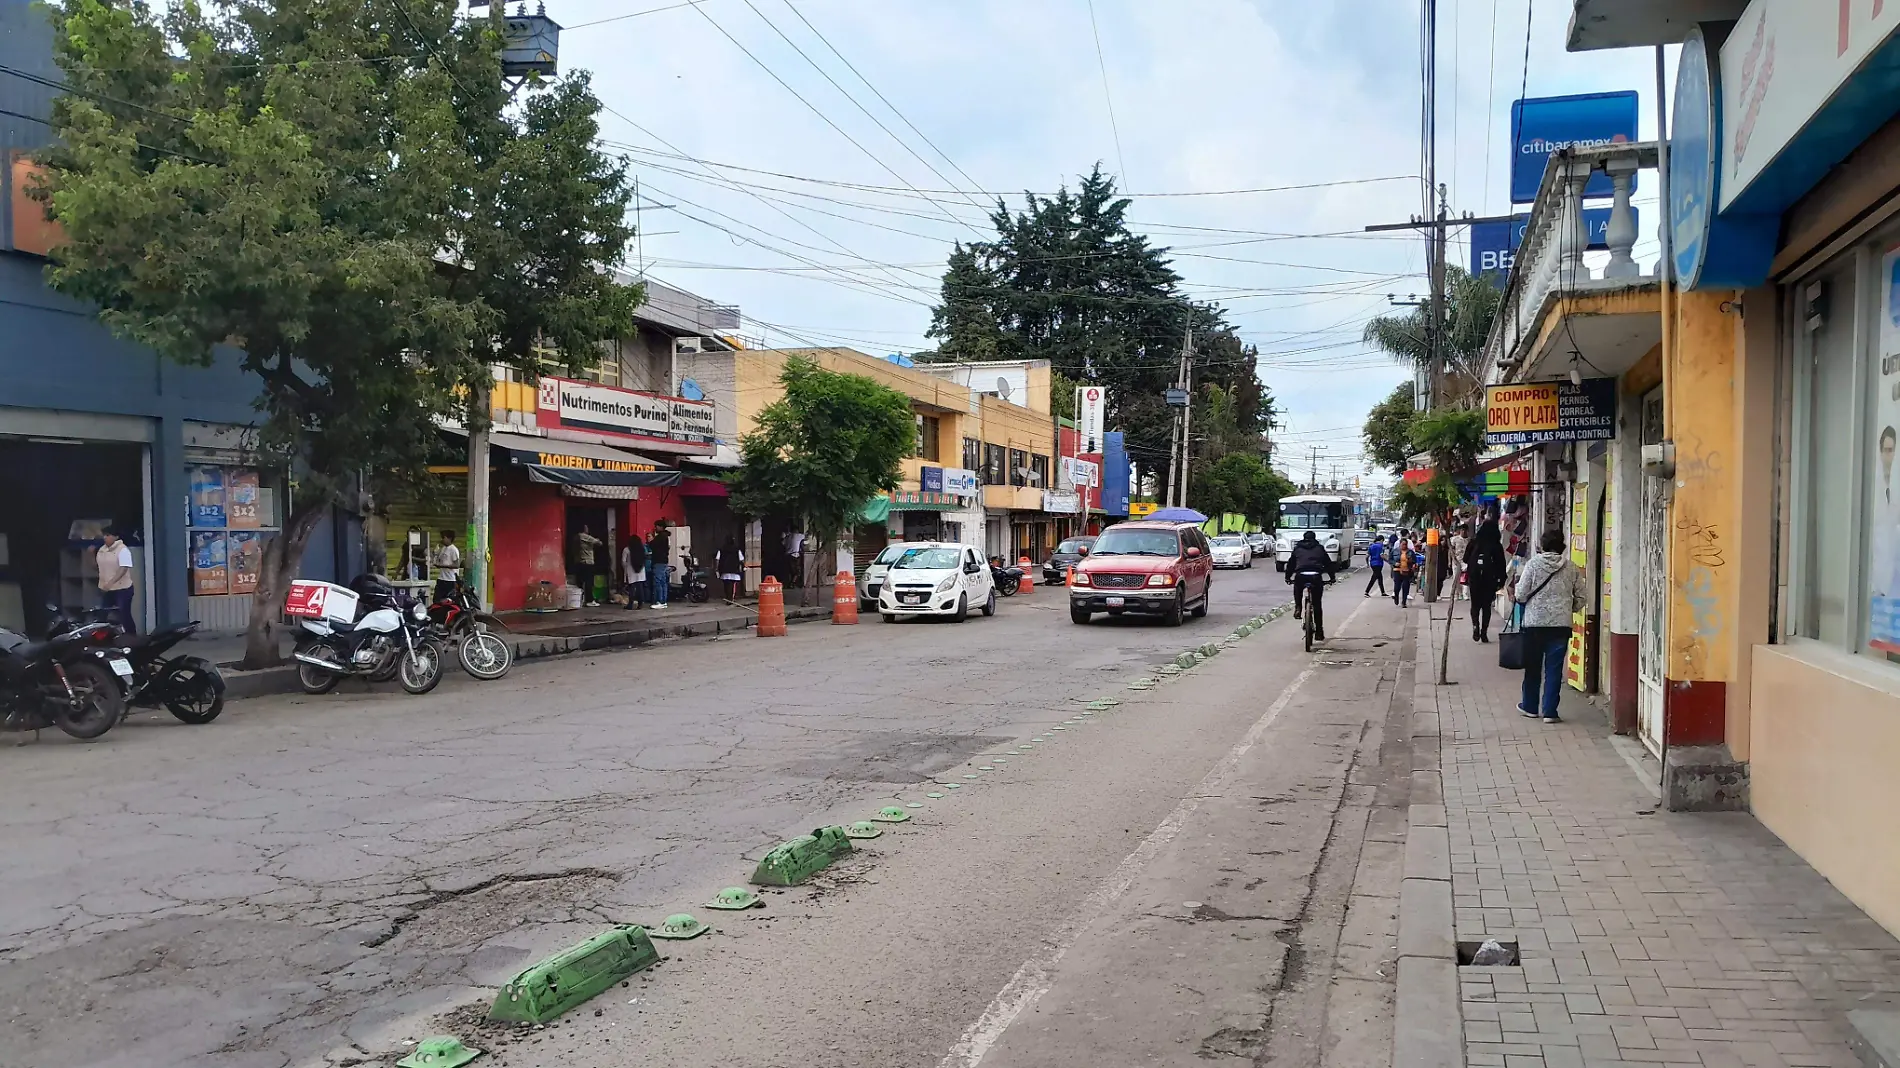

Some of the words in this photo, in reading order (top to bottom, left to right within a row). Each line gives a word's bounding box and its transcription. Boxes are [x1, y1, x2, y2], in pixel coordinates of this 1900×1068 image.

[1559, 385, 1581, 395] PILAS
[1495, 389, 1550, 403] COMPRO
[1559, 396, 1590, 406] PERNOS
[561, 391, 632, 418] Nutrimentos
[634, 404, 667, 423] Purina
[672, 403, 712, 421] Alimentos
[1559, 406, 1595, 416] CORREAS
[1488, 407, 1510, 426] ORO
[1513, 407, 1521, 425] Y
[1523, 405, 1557, 425] PLATA
[1559, 416, 1611, 427] EXTENSIBLES
[683, 422, 713, 434] Fernando
[1487, 431, 1527, 443] RELOJERÍA
[1532, 431, 1554, 442] PILAS
[1555, 430, 1576, 440] PARA
[1577, 428, 1612, 440] CONTROL
[538, 453, 593, 470] TAQUERIA
[200, 506, 219, 516] 3x2
[233, 506, 256, 517] 3x2
[237, 573, 257, 584] 3x2
